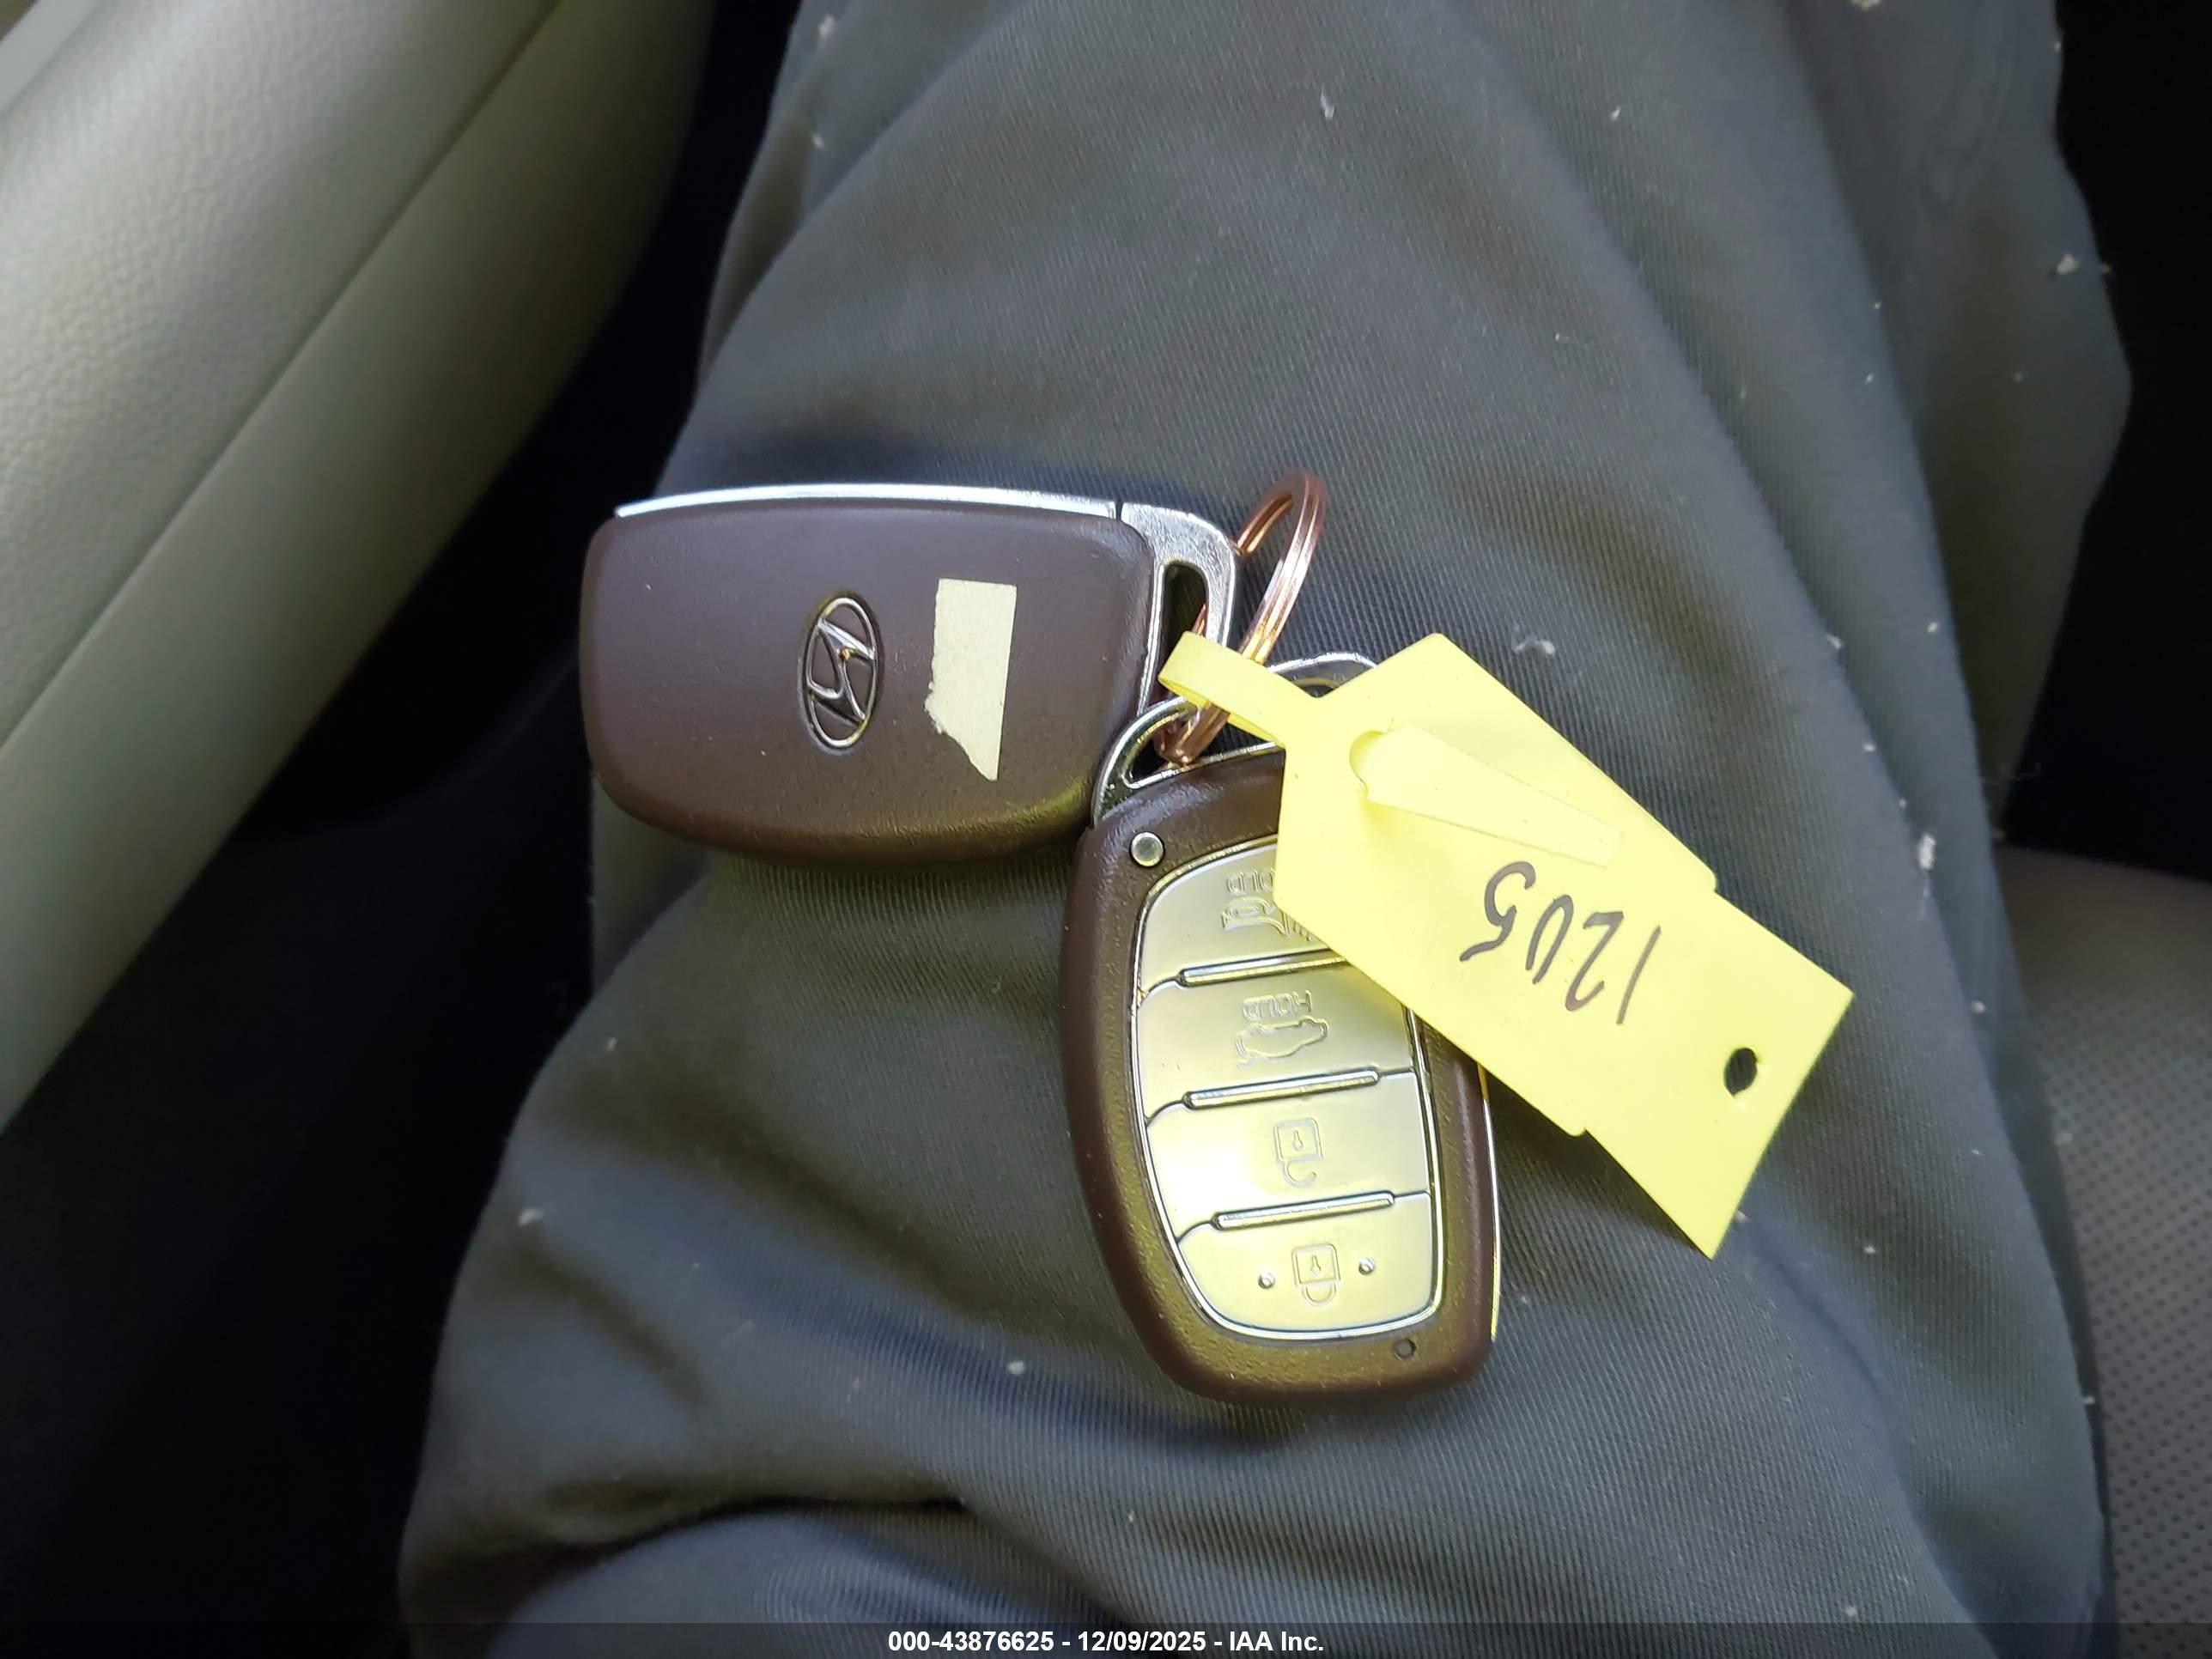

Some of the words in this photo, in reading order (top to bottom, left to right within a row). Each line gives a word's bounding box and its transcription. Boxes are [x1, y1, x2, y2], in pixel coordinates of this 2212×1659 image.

[1225, 868, 1276, 895] OLD
[1459, 860, 1662, 1025] 1205
[1243, 989, 1313, 1021] HOLD
